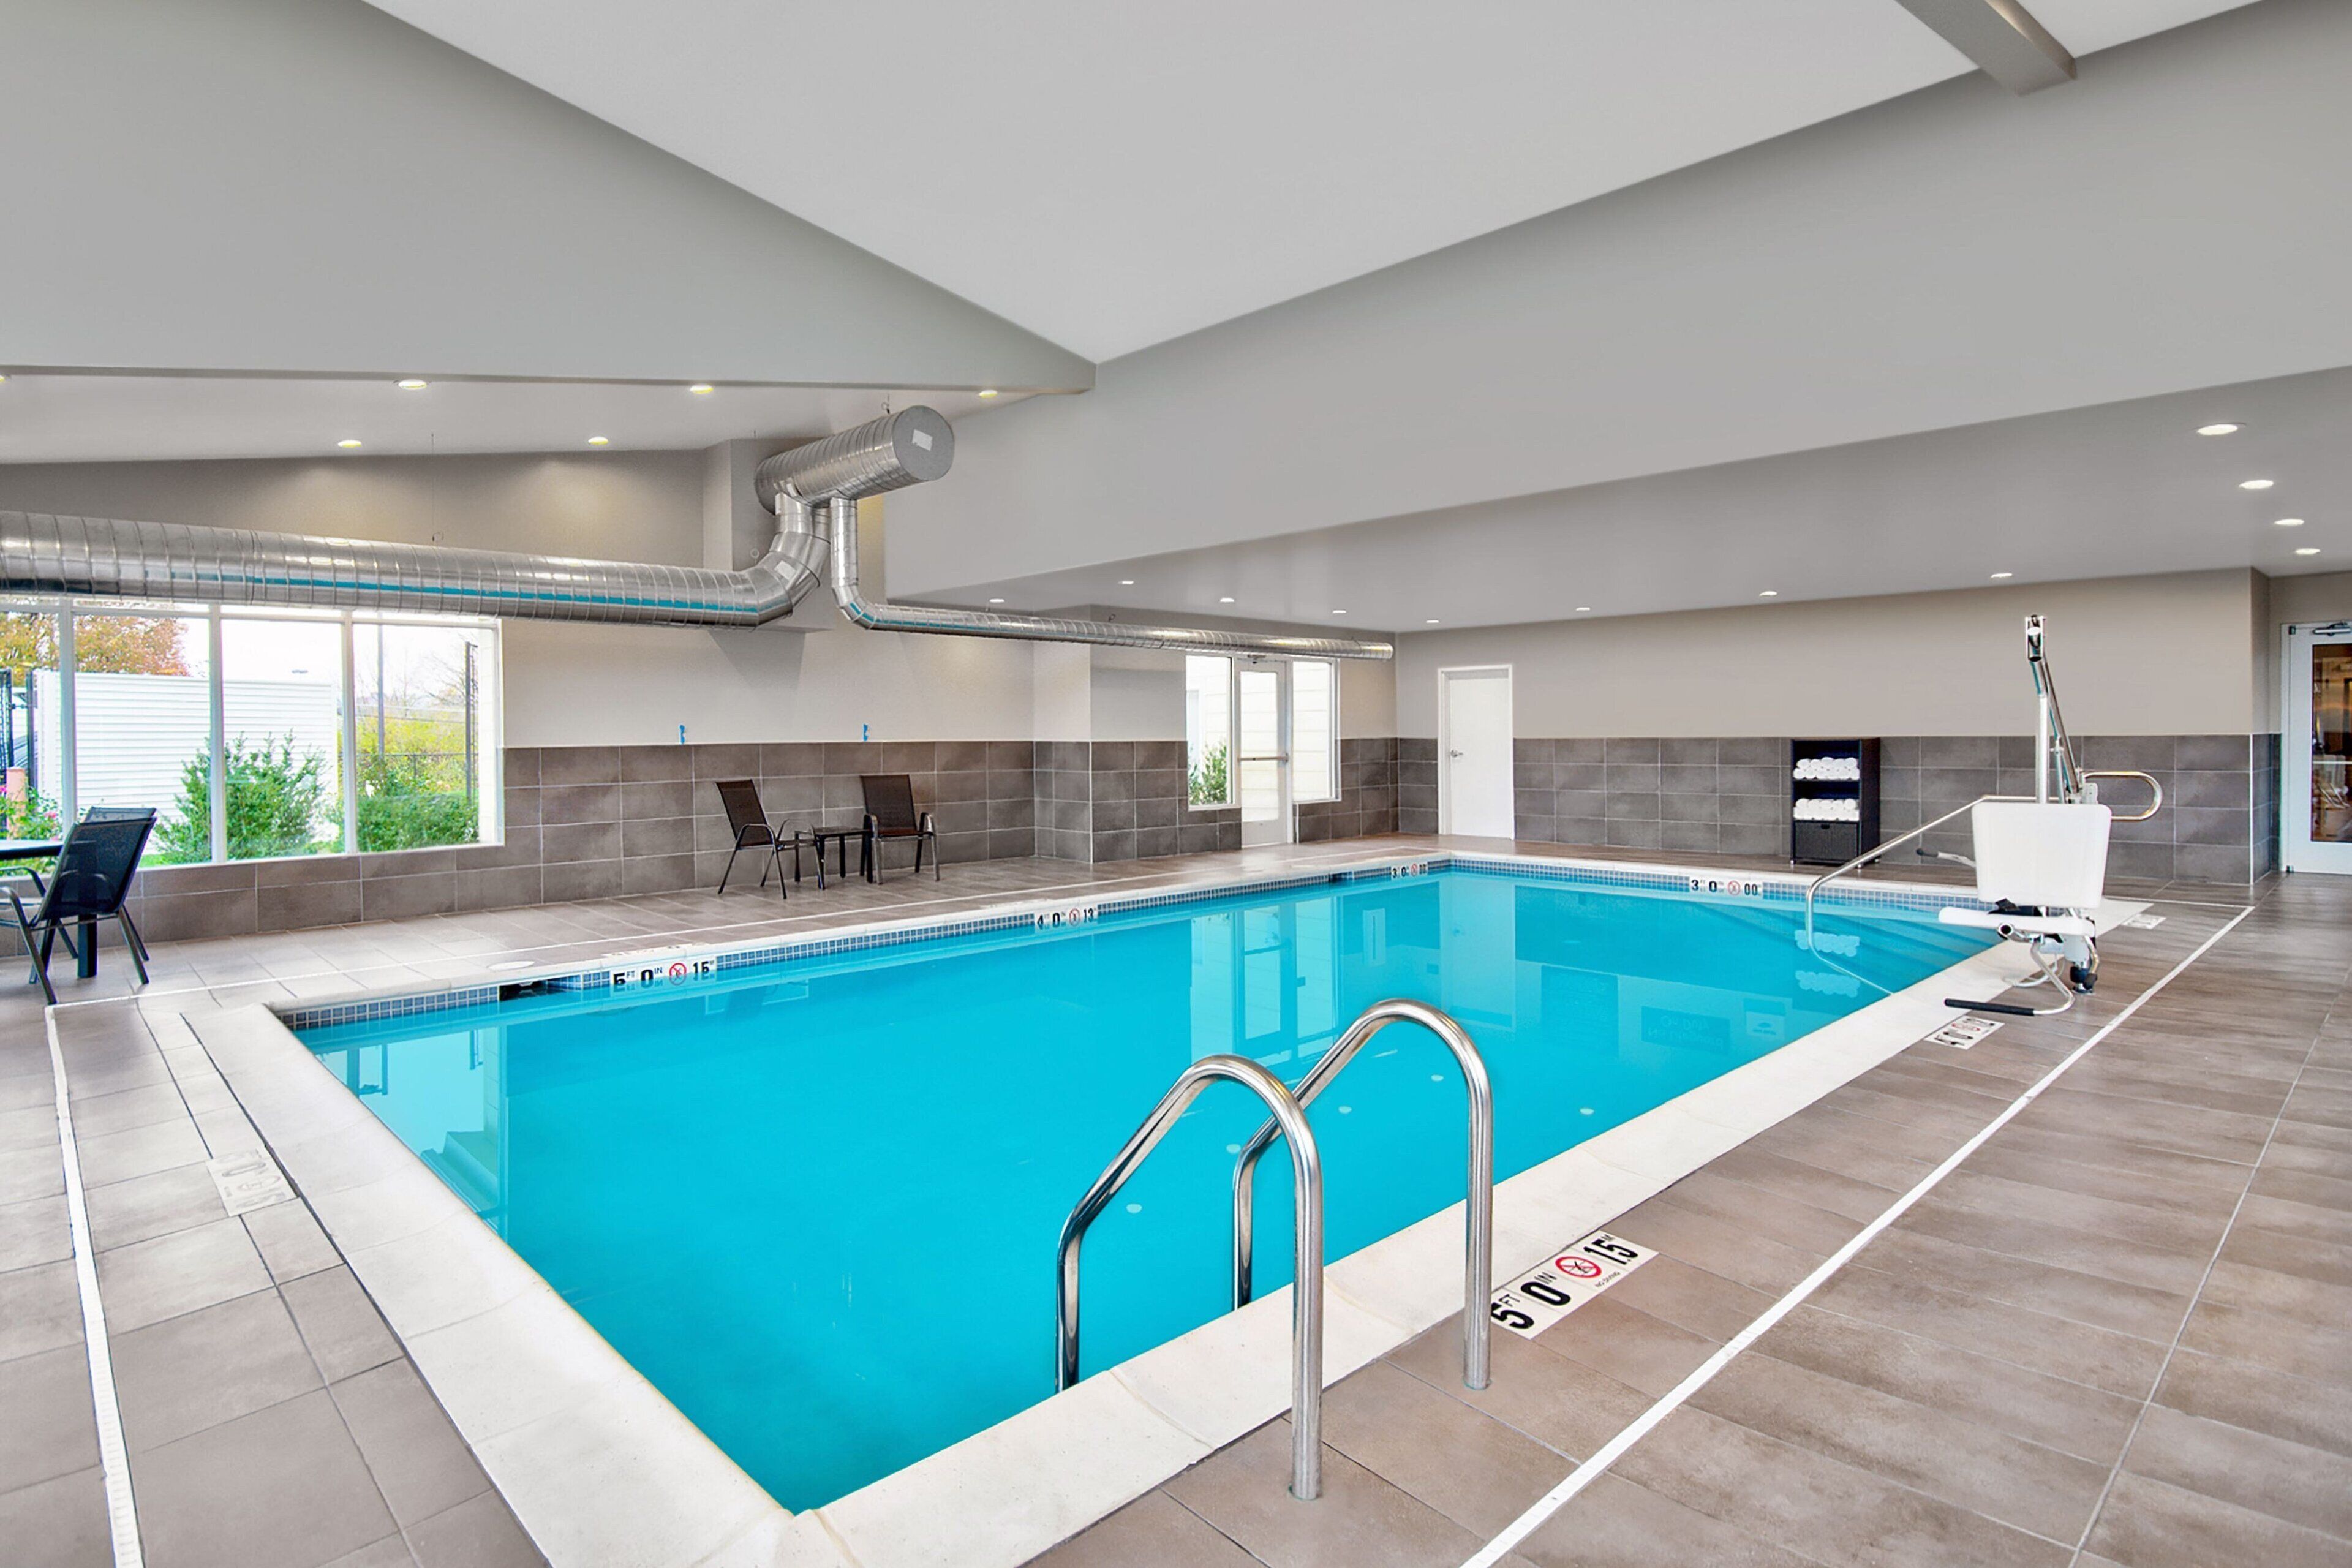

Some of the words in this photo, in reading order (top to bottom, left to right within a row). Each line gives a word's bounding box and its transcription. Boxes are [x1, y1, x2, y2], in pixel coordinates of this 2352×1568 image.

[1709, 881, 1717, 892] 0
[1534, 1272, 1557, 1284] IN
[1520, 1281, 1571, 1306] 0
[1498, 1294, 1521, 1308] FT
[1491, 1302, 1535, 1329] 5
